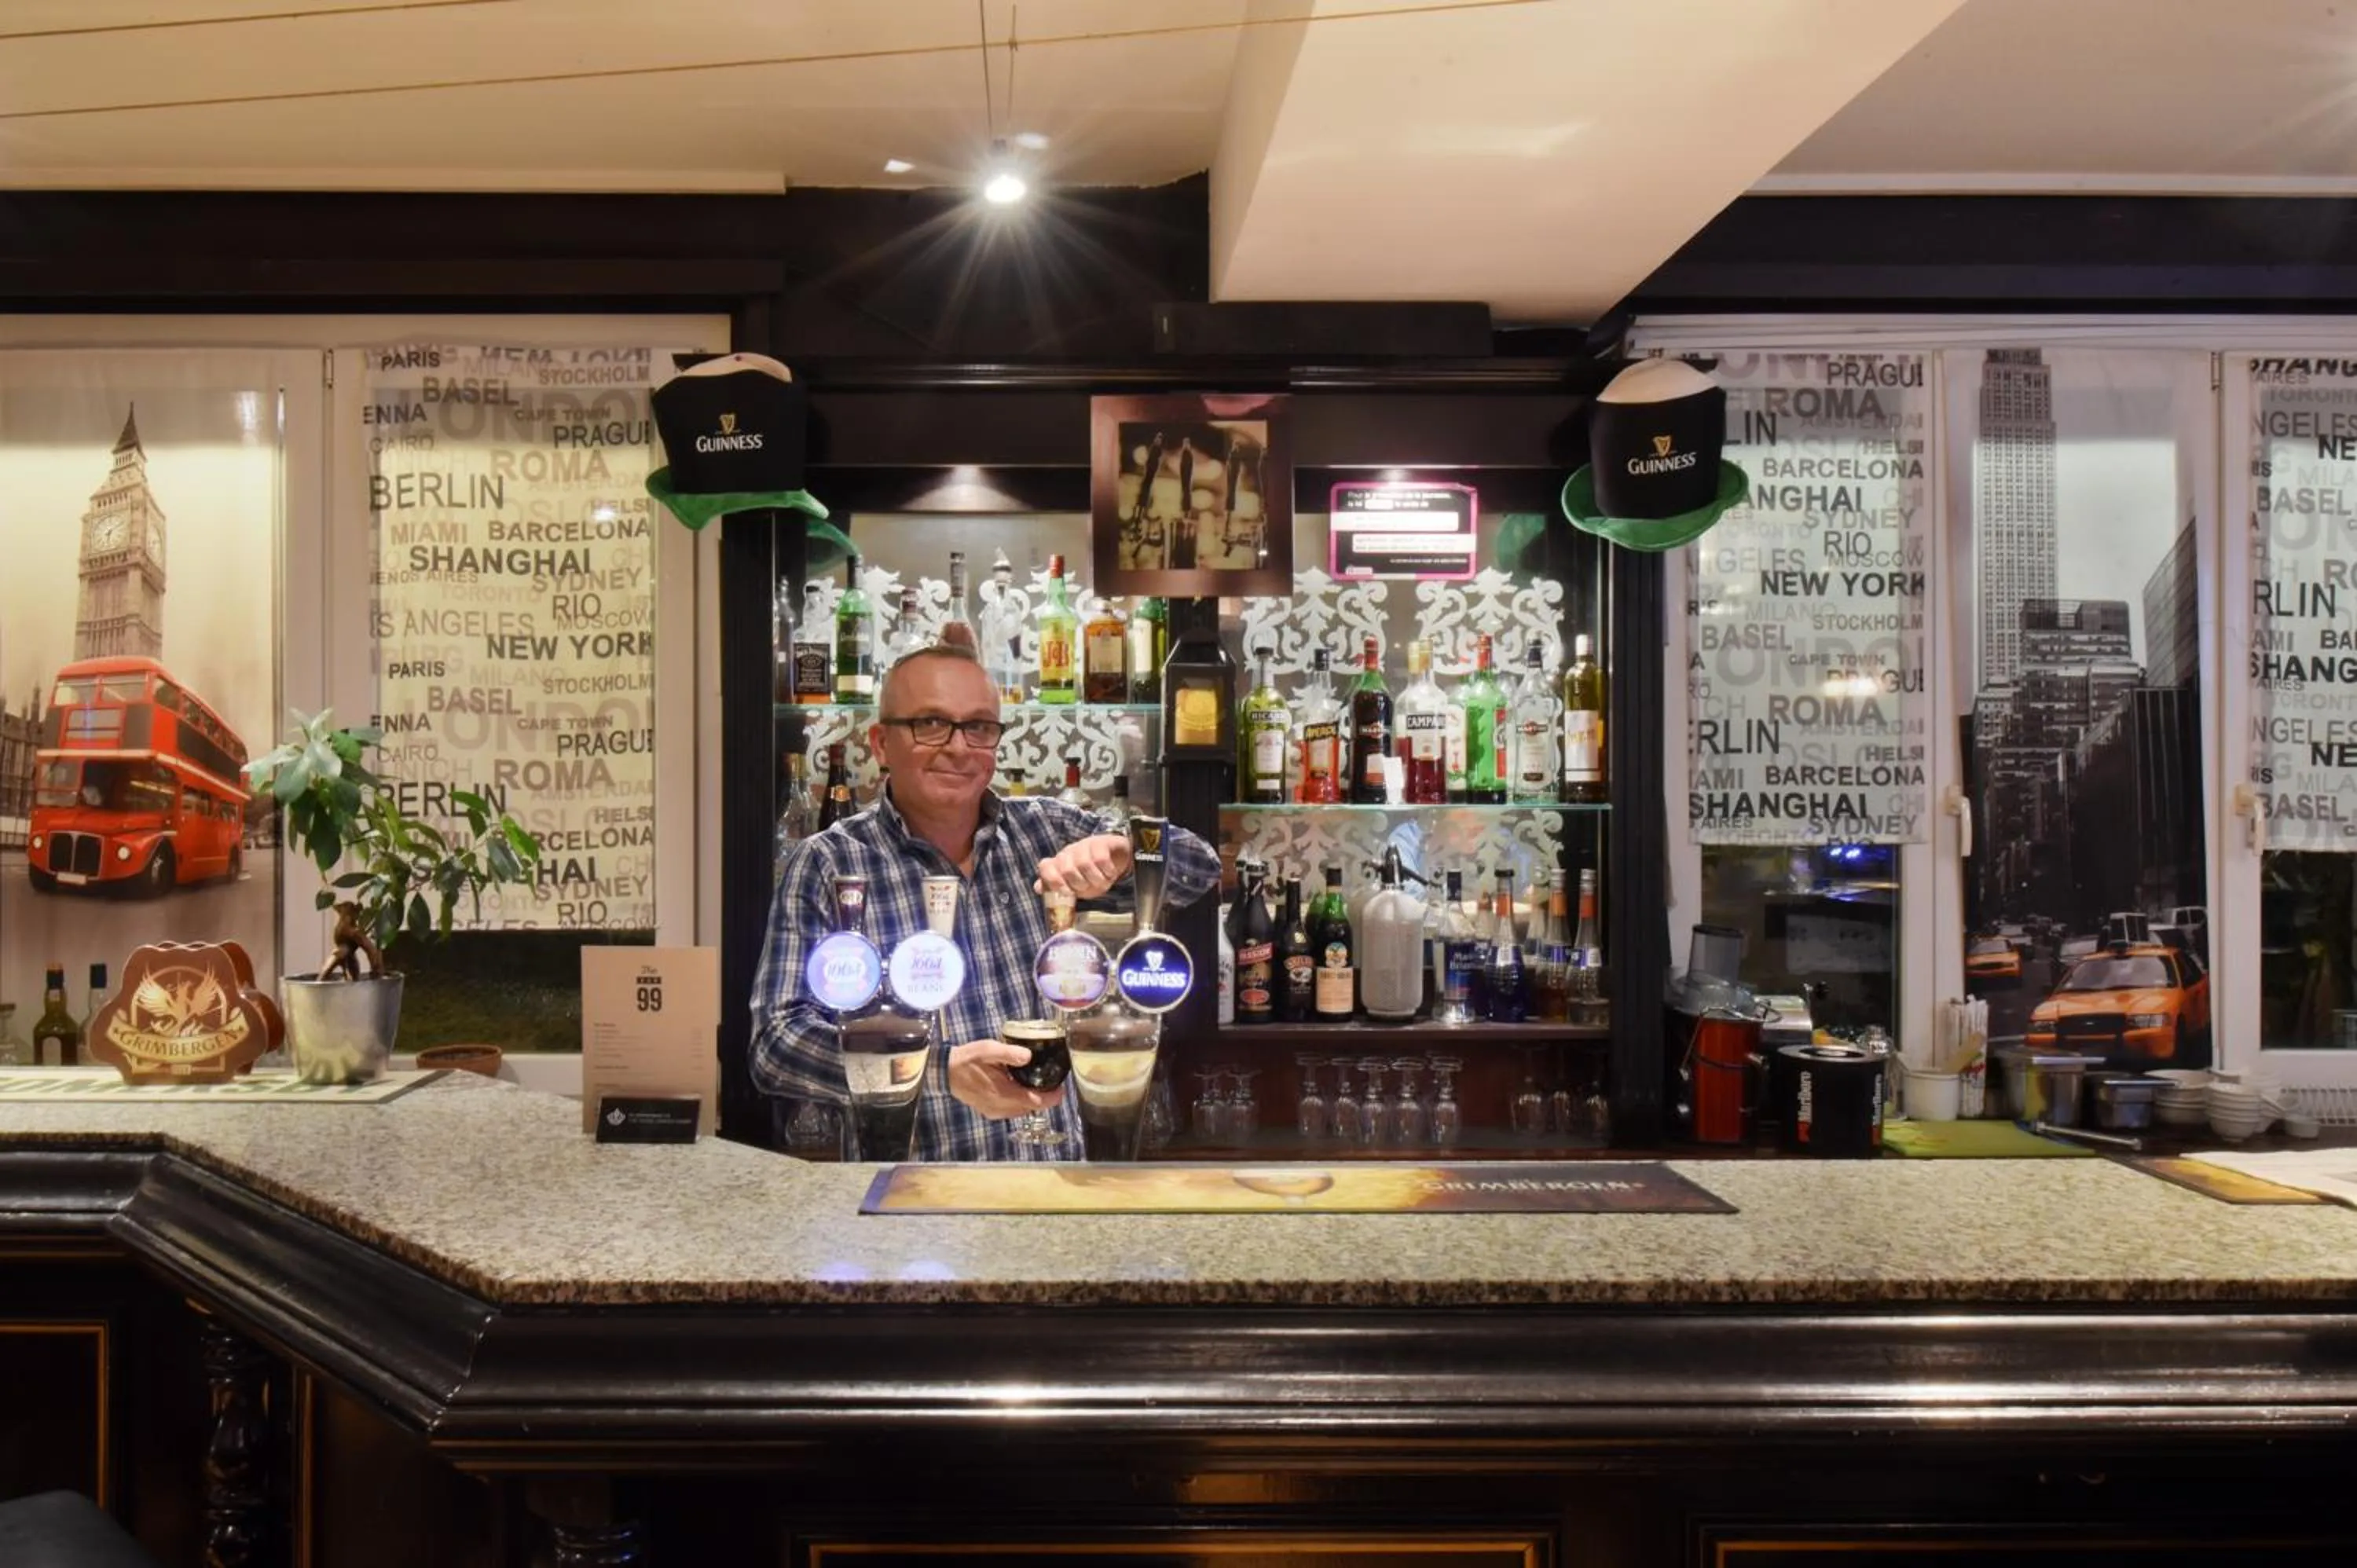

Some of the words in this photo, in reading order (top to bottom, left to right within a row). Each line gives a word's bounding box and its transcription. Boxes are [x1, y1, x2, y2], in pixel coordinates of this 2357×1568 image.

[381, 352, 441, 372] PARIS
[539, 367, 649, 385] STOCKHOLM
[423, 377, 519, 405] BASEL
[1764, 388, 1886, 419] ROMA
[696, 434, 764, 452] GUINNESS
[489, 449, 611, 482] ROMA
[1628, 452, 1697, 475] GUINNESS
[1763, 458, 1923, 479] BARCELONA
[368, 472, 504, 512] BERLIN
[2256, 486, 2352, 515] BASEL
[488, 518, 651, 543] BARCELONA
[1804, 509, 1914, 529] SYDNEY
[391, 522, 467, 544] MIAMI
[1824, 531, 1871, 557] RIO
[409, 545, 590, 577] SHANGHAI
[532, 566, 643, 594] SYDNEY
[1761, 571, 1830, 597] NEW
[552, 592, 602, 621] RIO
[1813, 614, 1923, 631] STOCKHOLM
[487, 635, 559, 660] NEW
[1701, 625, 1792, 651] BASEL
[389, 661, 445, 679] PARIS
[427, 686, 522, 715] BASEL
[1769, 694, 1886, 727] ROMA
[493, 758, 613, 792] ROMA
[1766, 766, 1924, 787] BARCELONA
[1689, 792, 1867, 819] SHANGHAI
[1809, 815, 1917, 836] SYDNEY
[1135, 852, 1164, 861] GUINNESS
[536, 876, 648, 902] SYDNEY
[557, 901, 607, 925] RIO
[1121, 969, 1187, 987] GUINNESS
[636, 987, 662, 1012] 99
[119, 1029, 240, 1057] GRIMBERGEN
